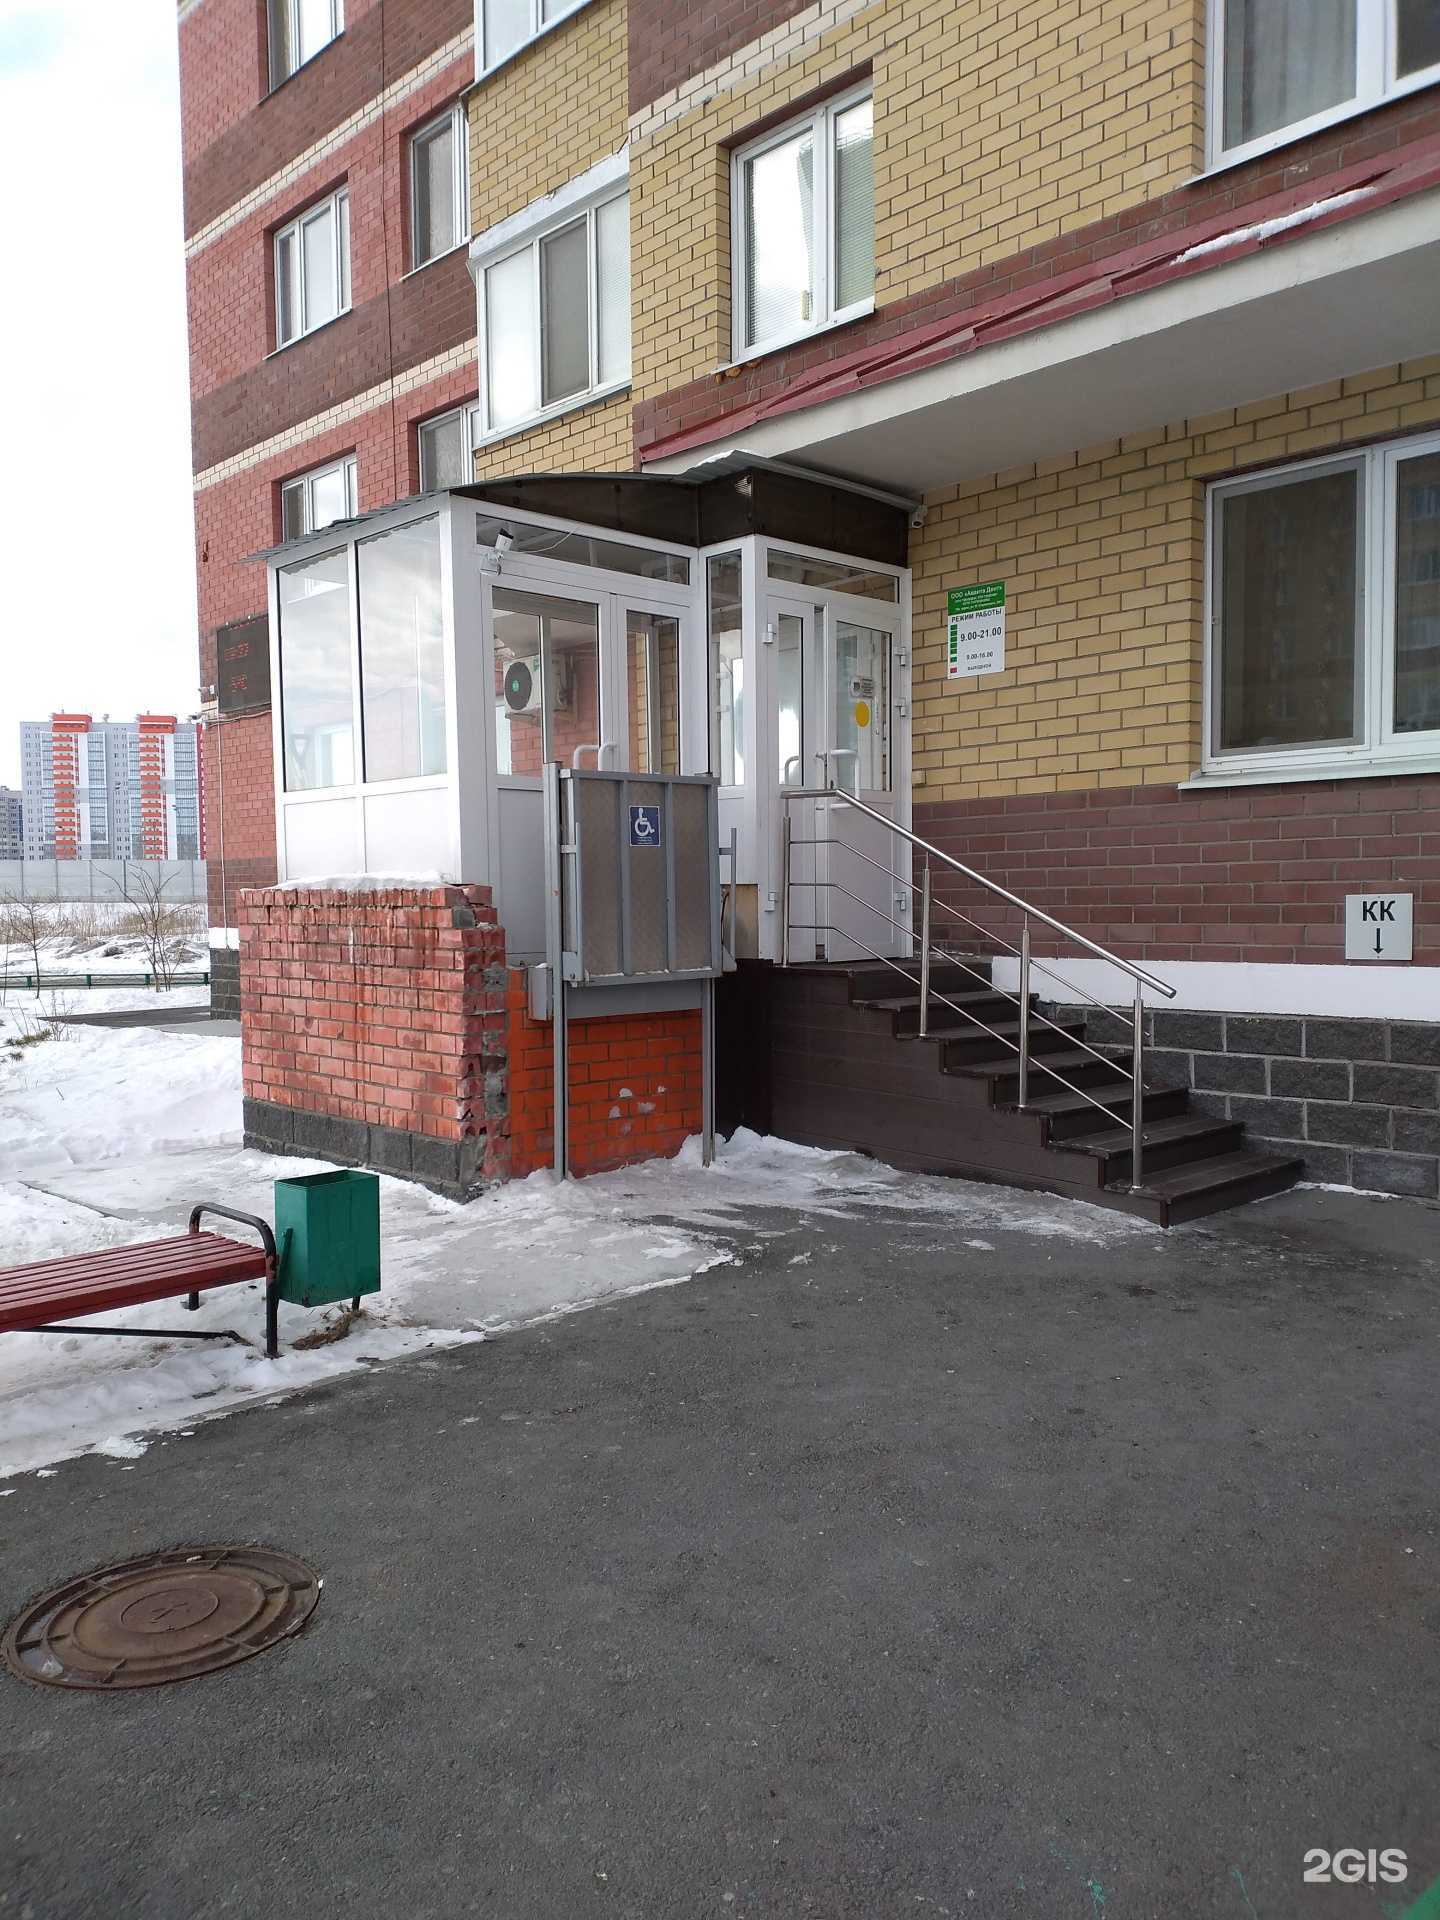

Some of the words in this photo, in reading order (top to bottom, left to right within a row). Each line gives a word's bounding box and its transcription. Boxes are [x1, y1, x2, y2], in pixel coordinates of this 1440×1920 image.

[951, 613, 974, 622] РЕЖИМ
[975, 608, 1001, 619] РАБОТЫ
[960, 626, 1002, 641] 9.00-21.00
[1362, 900, 1396, 922] КК
